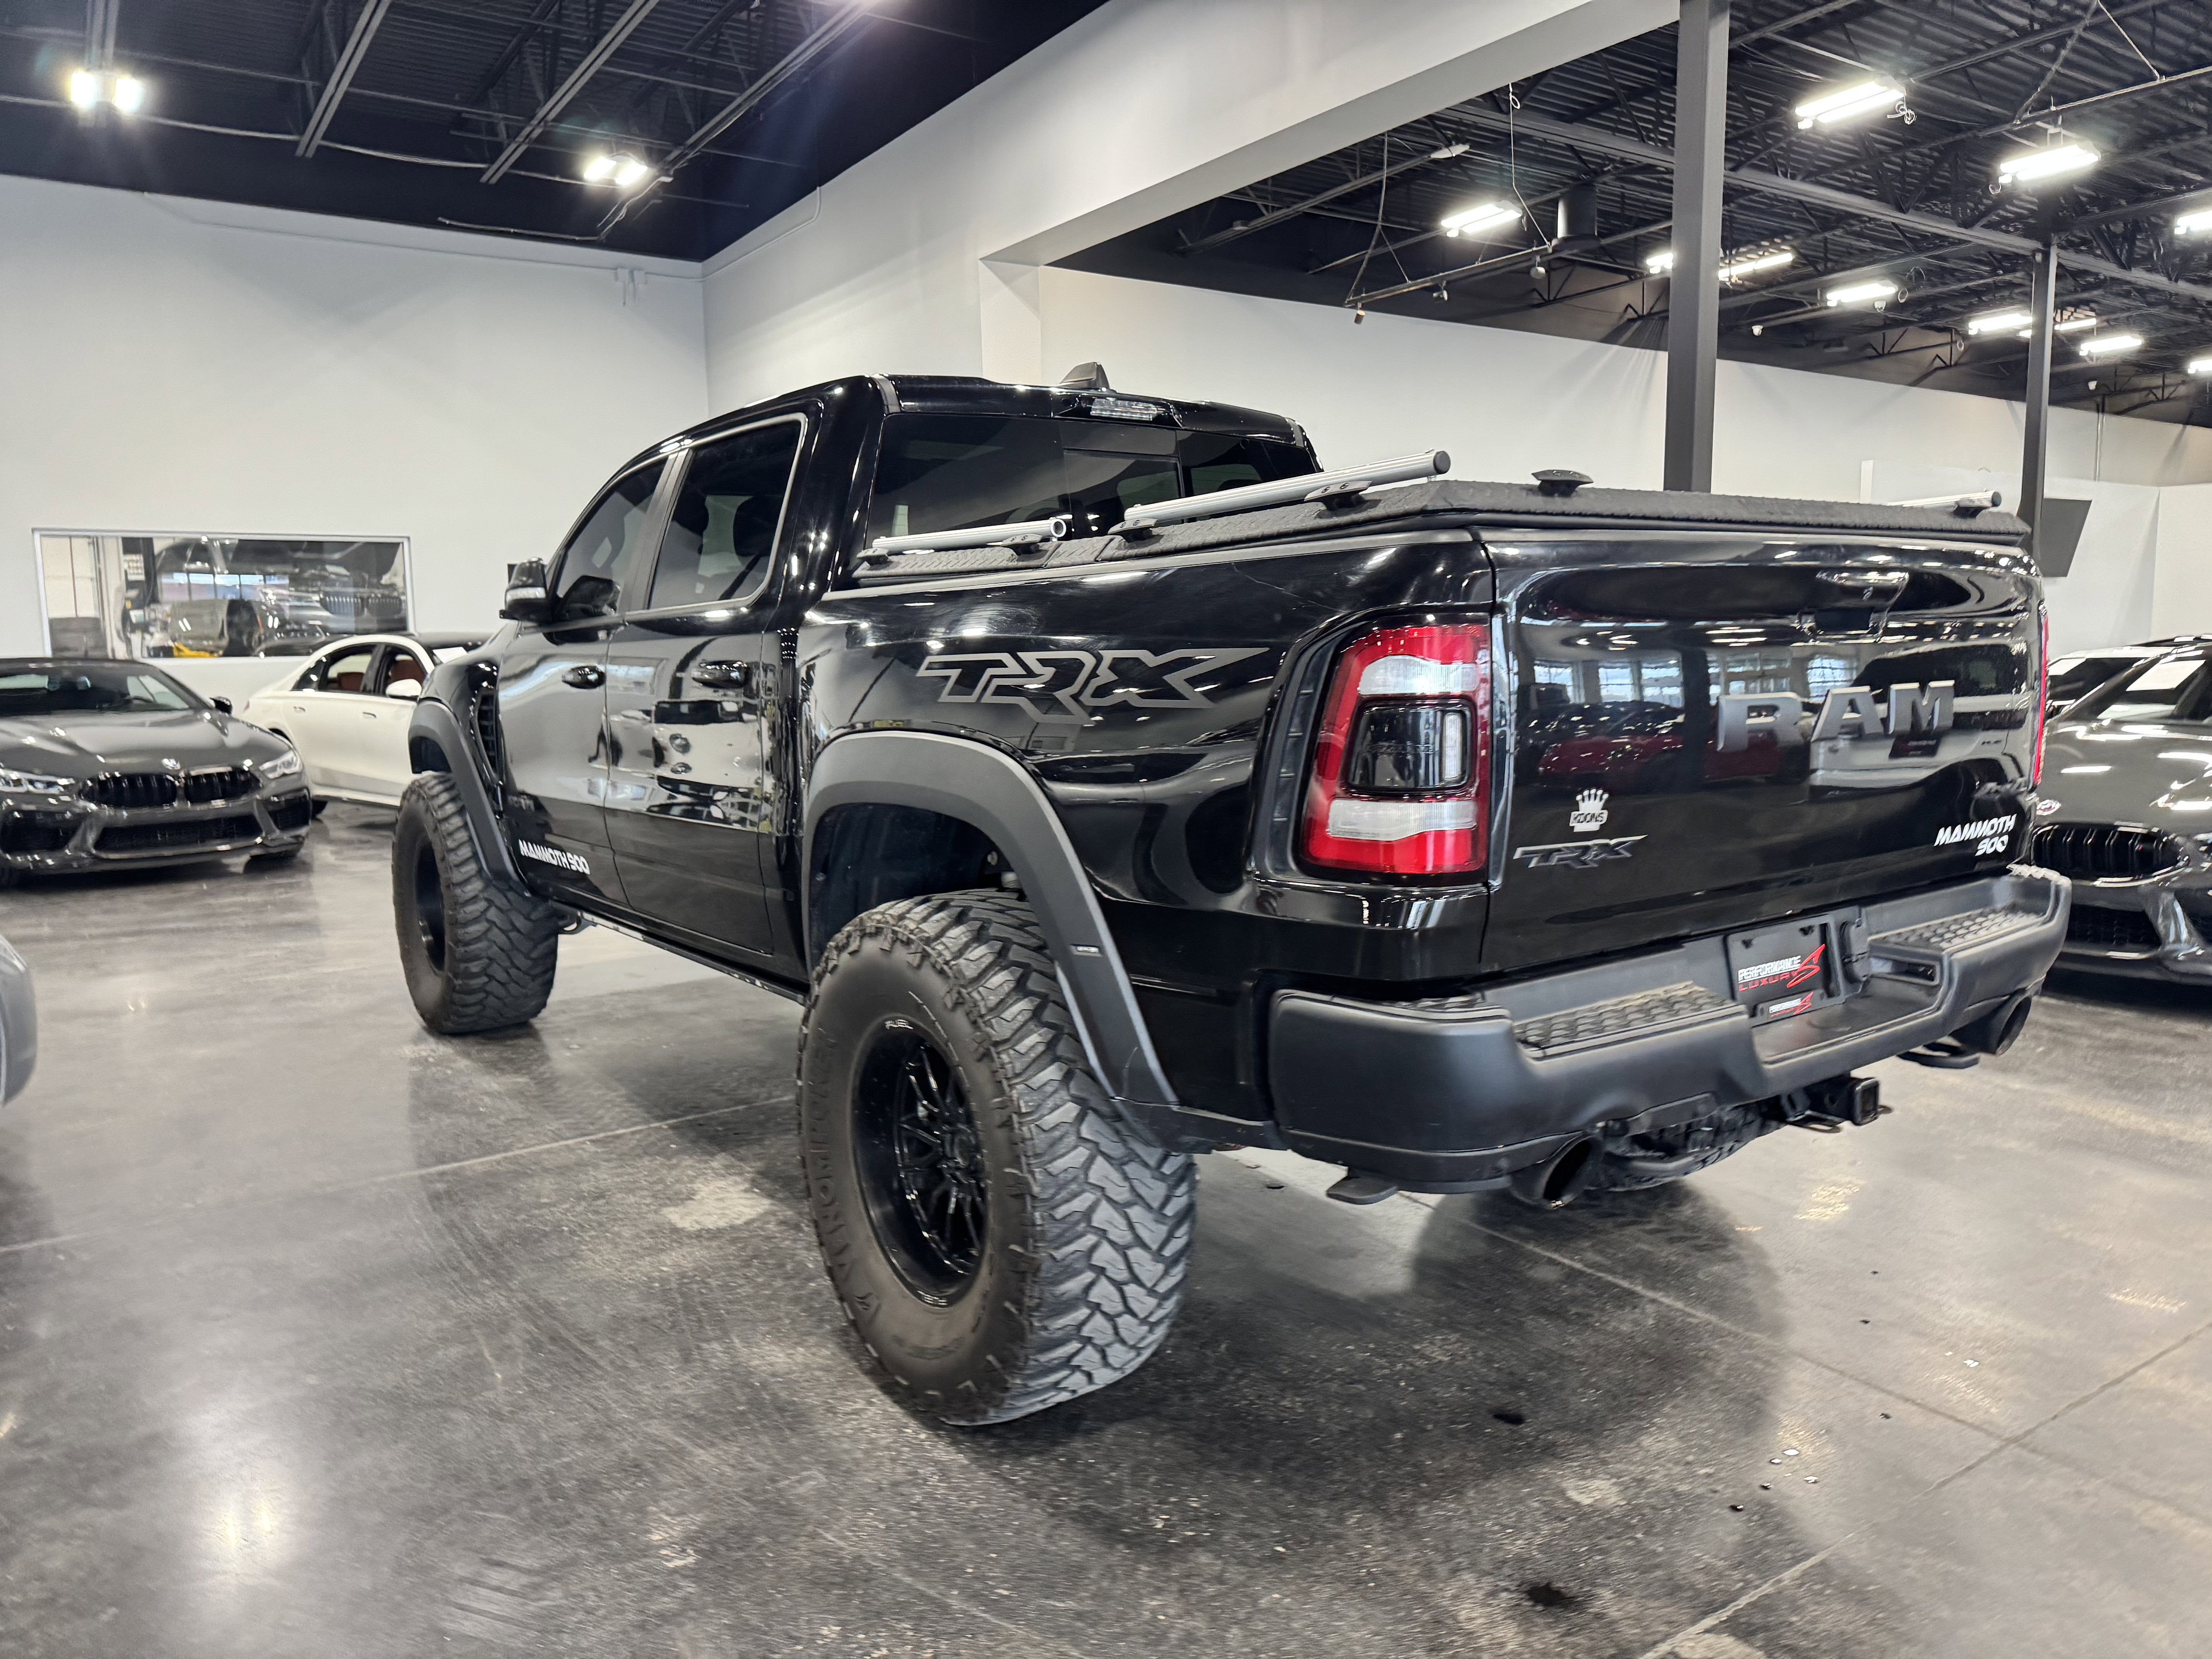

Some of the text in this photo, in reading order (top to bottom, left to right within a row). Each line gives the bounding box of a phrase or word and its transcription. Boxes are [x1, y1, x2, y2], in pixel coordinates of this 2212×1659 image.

[915, 647, 1270, 726] TRX
[1717, 680, 1955, 752] RAM
[1571, 812, 1604, 823] KOONS
[1934, 814, 2017, 847] MAMMOTH
[519, 839, 591, 875] MAMMOTH 900
[1513, 835, 1648, 869] TRX
[1975, 835, 2009, 857] 900
